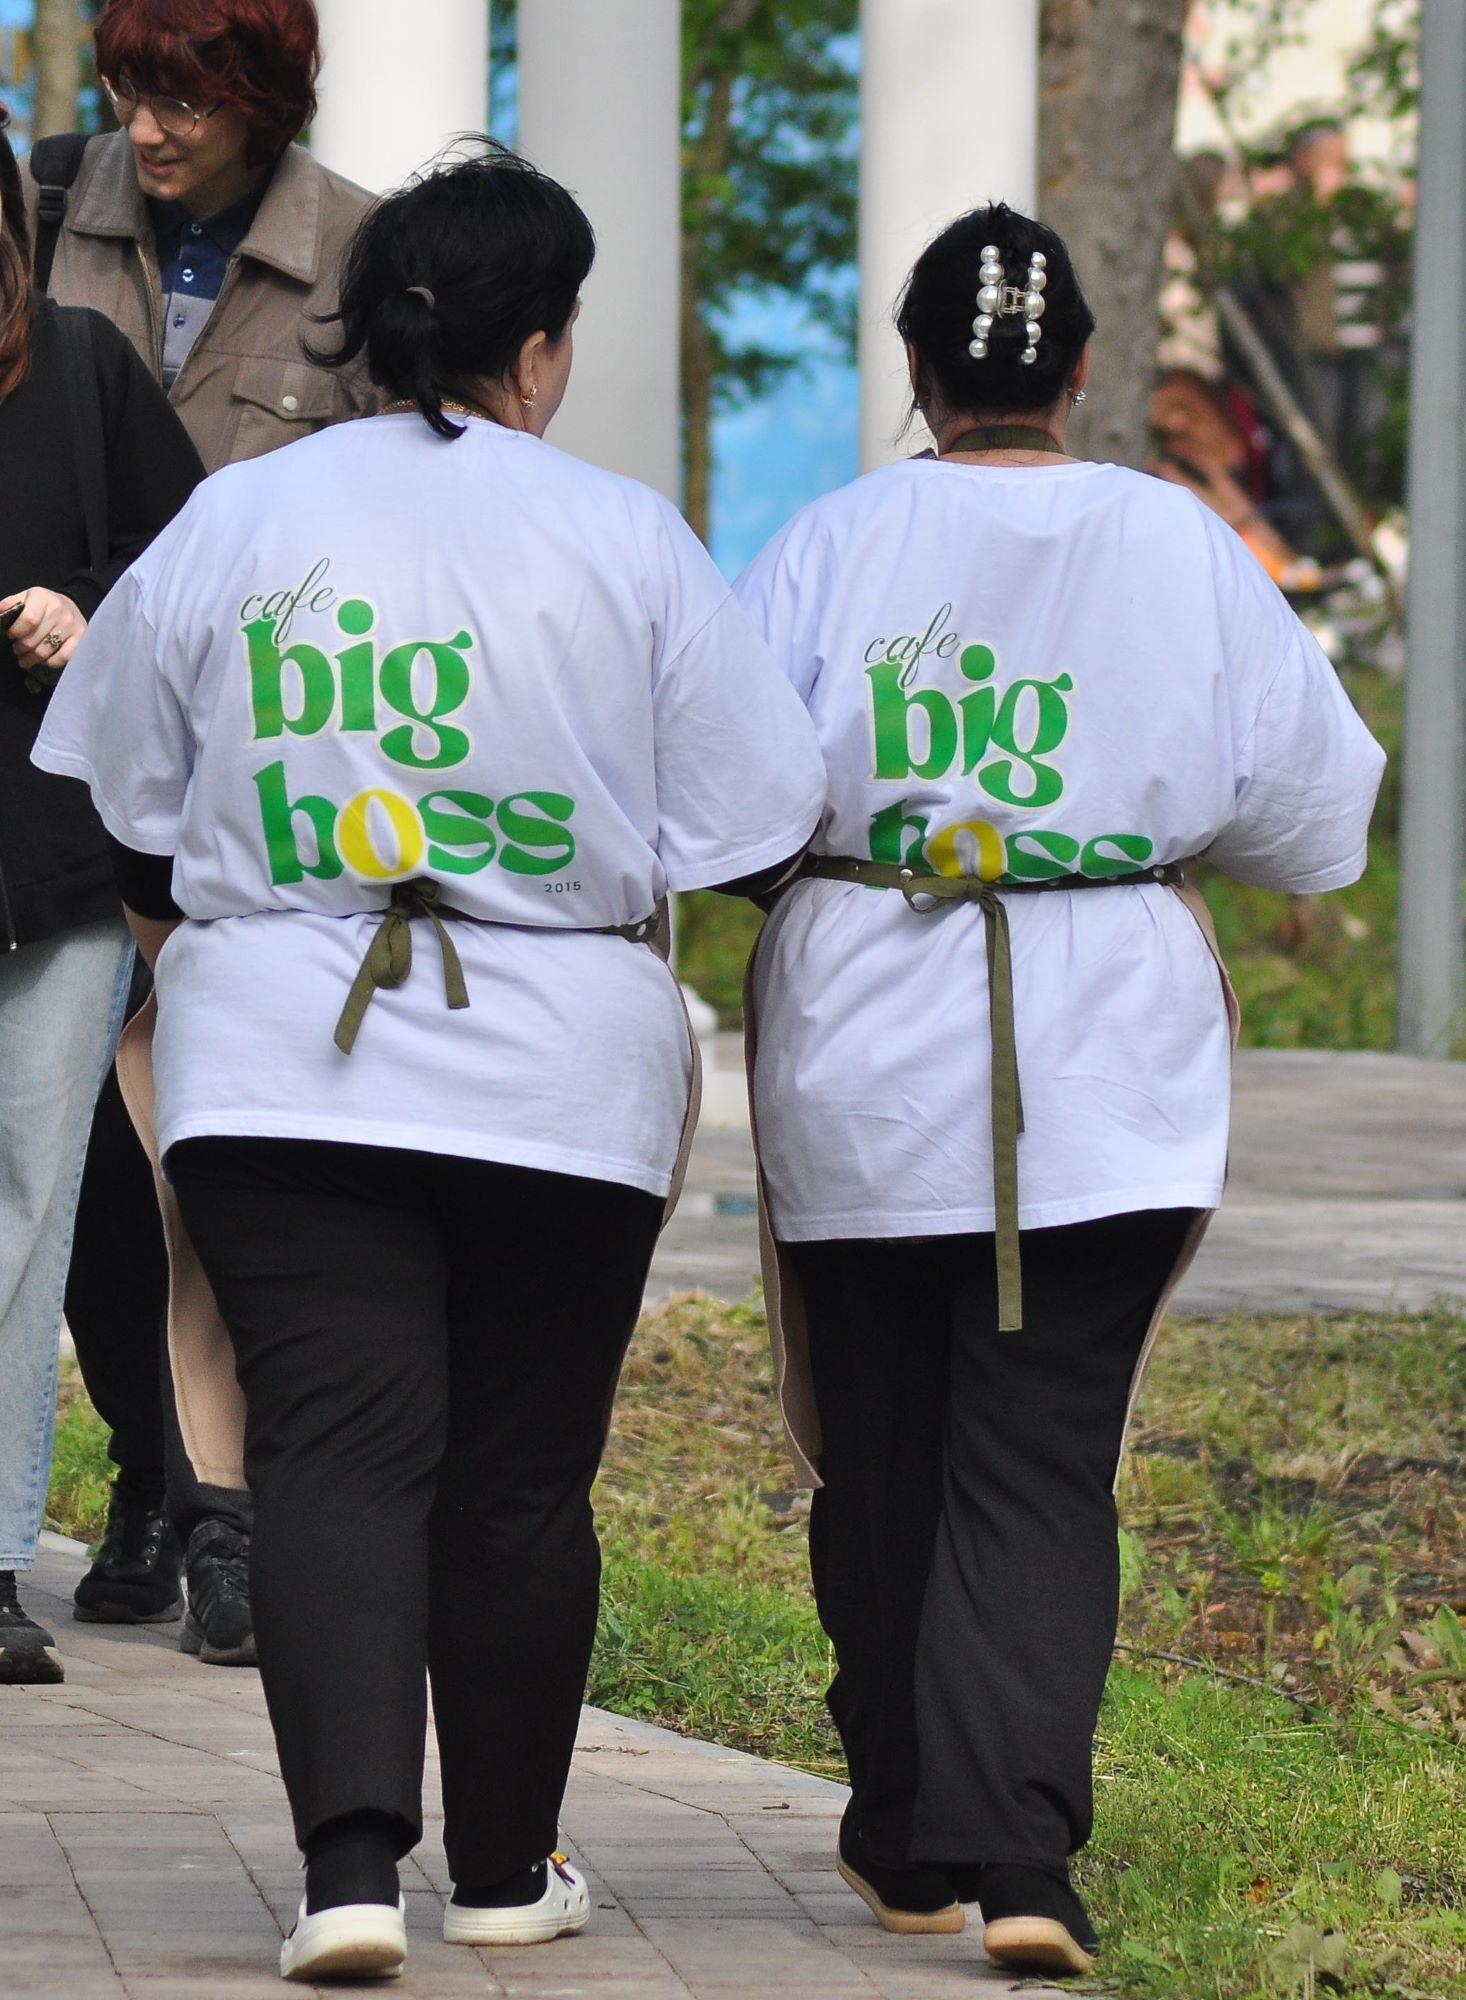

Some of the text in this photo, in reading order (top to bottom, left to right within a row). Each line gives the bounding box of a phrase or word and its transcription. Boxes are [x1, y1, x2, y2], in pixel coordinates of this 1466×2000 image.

[240, 558, 338, 644] cafe
[864, 602, 959, 687] cafe
[240, 599, 474, 769] big
[864, 644, 1073, 808] big
[252, 760, 575, 886] boss
[544, 880, 582, 894] 2015
